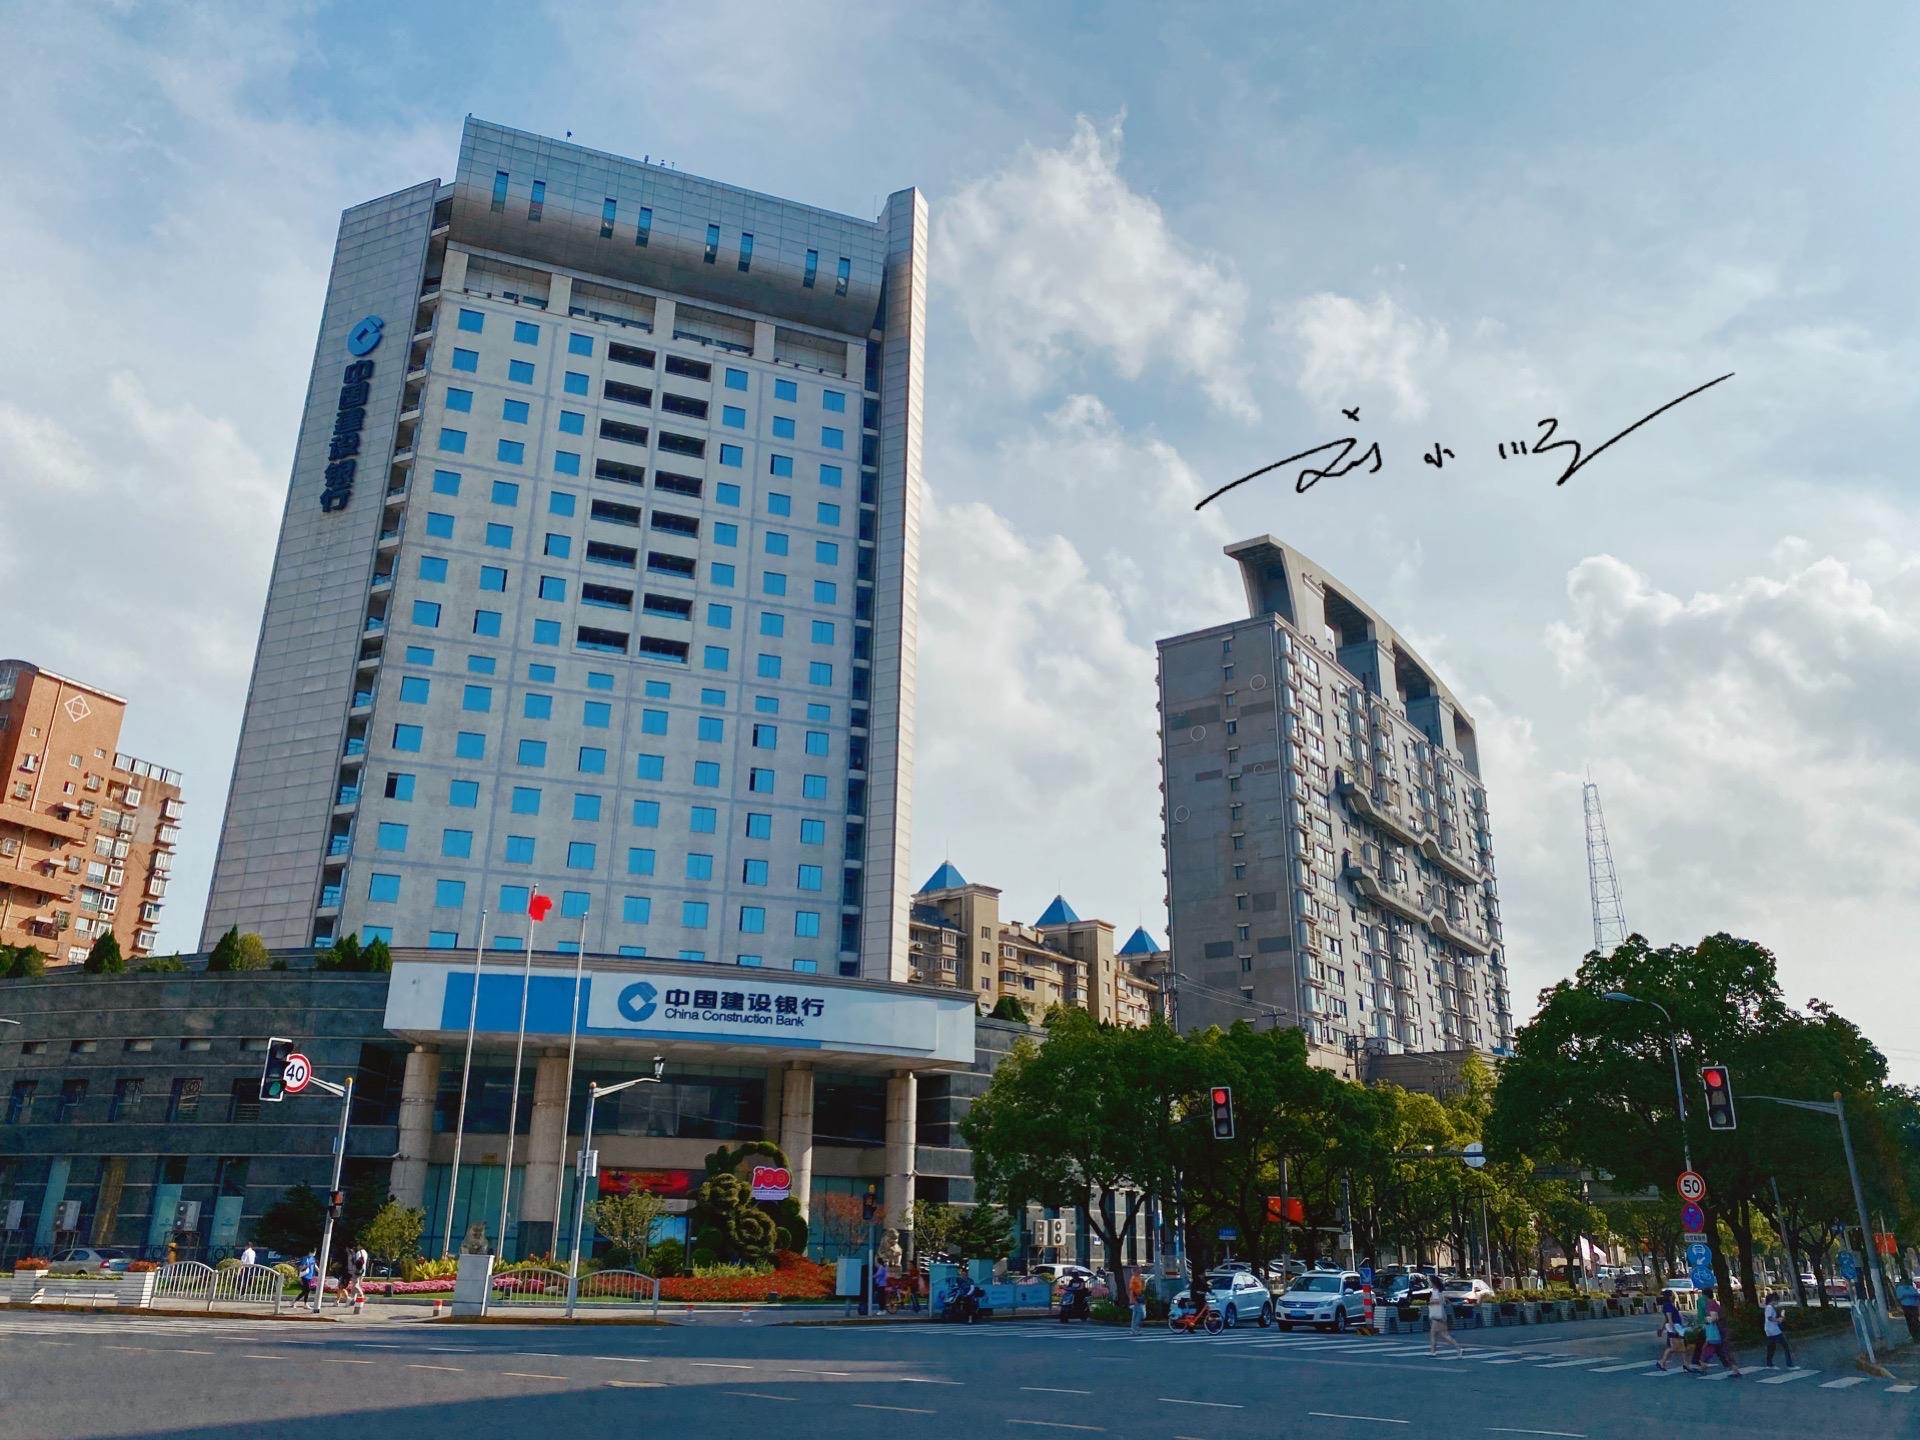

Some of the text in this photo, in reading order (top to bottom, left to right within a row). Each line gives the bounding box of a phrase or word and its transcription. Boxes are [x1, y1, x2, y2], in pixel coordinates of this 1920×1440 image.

[320, 360, 375, 512] 中国建设银行
[665, 988, 825, 1017] 中国建设银行
[664, 1008, 805, 1028] China Construction Bank
[285, 1064, 305, 1083] 40
[1683, 1178, 1701, 1191] 50
